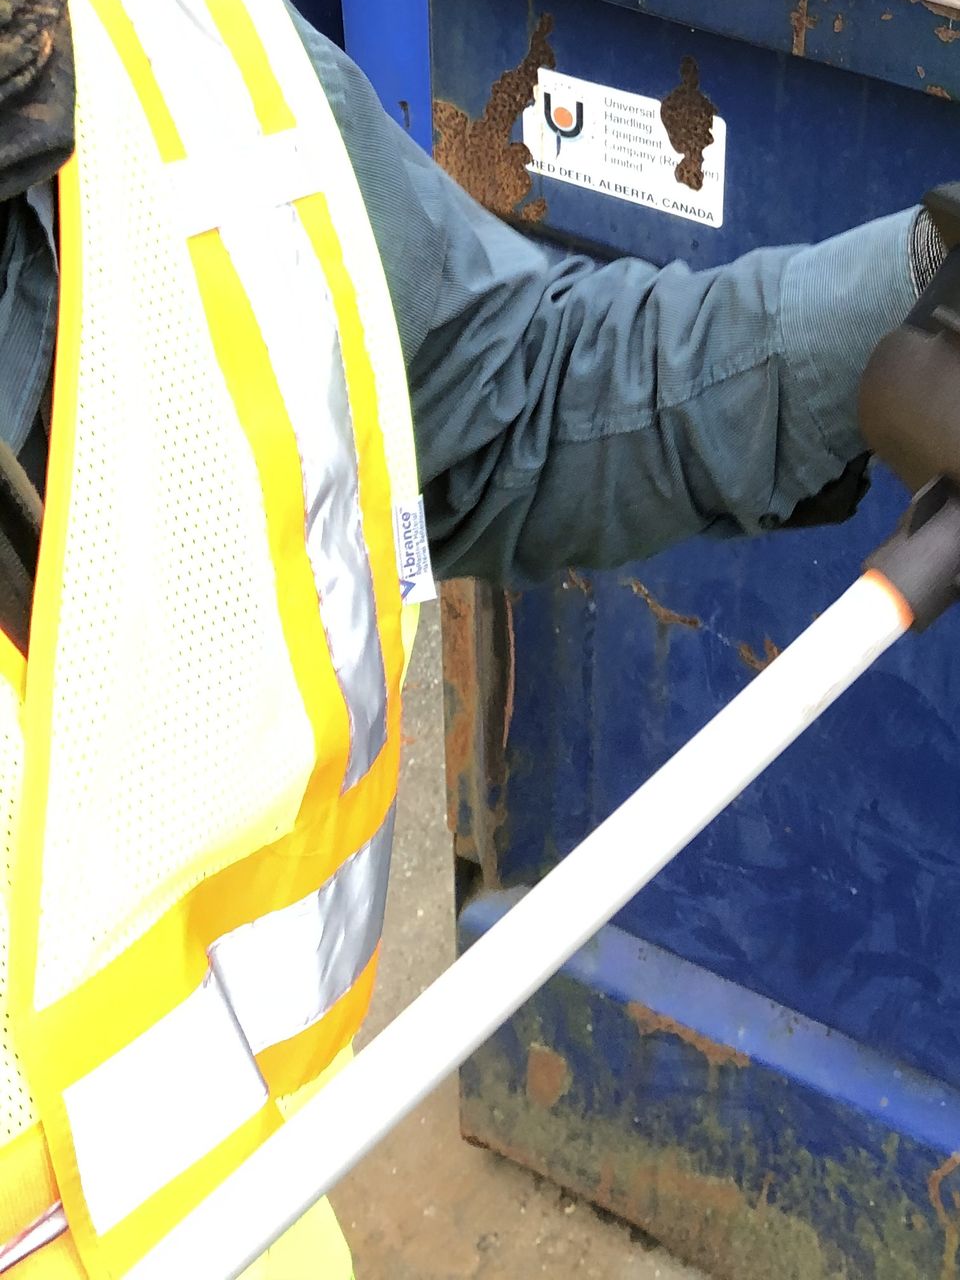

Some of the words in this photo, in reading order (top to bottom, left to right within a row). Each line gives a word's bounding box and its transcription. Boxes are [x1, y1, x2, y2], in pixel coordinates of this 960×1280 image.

[604, 97, 655, 119] Universal
[604, 111, 653, 134] Handling
[604, 124, 662, 149] Equipment
[604, 139, 656, 163] Company
[604, 153, 643, 172] Limited
[531, 160, 556, 173] RED
[662, 198, 715, 222] CANADA
